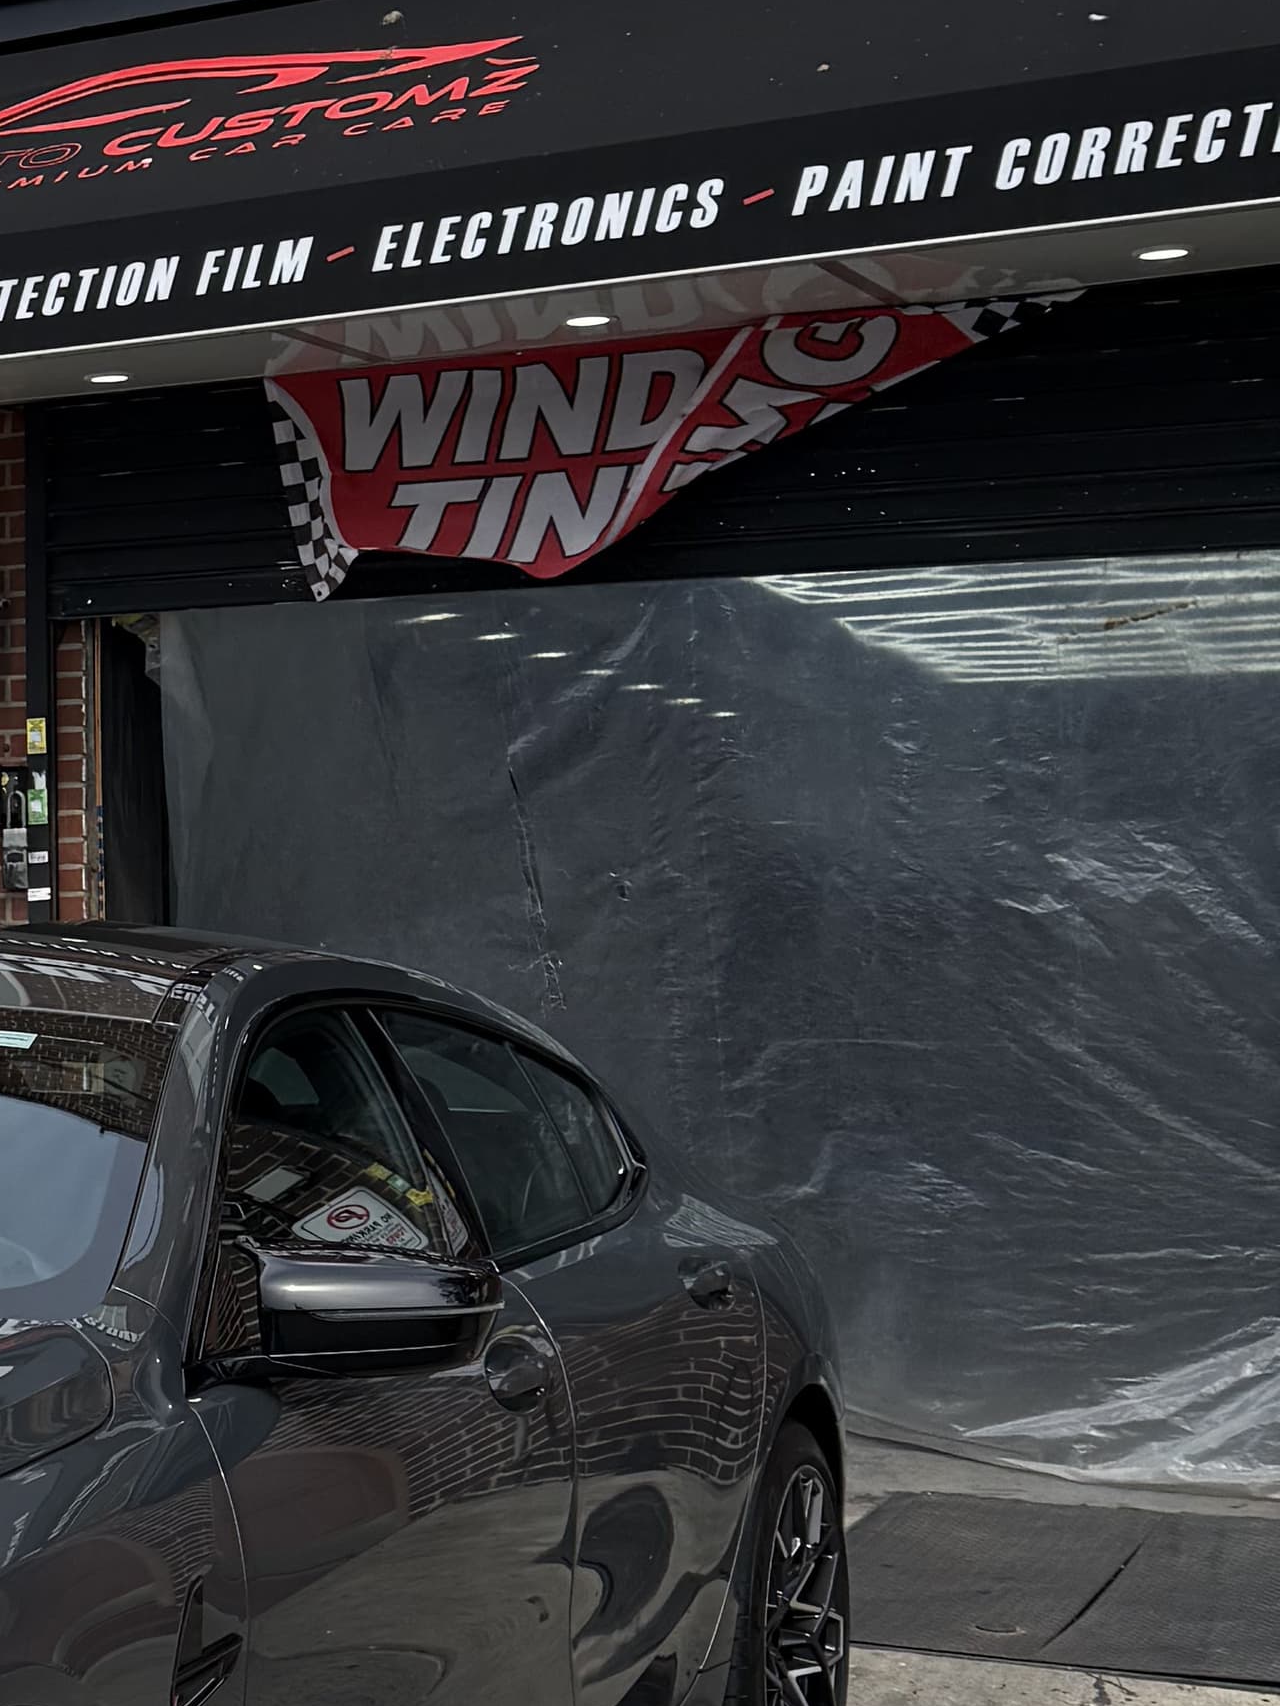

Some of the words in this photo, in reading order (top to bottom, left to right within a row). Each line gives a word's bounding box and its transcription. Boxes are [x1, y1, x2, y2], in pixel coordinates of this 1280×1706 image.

[102, 57, 540, 158] CUSTOMZ
[190, 132, 306, 162] CAR
[344, 99, 512, 136] CARE
[196, 236, 315, 296] FILM
[371, 176, 725, 274] ELECTRONICS
[791, 144, 973, 217] PAINT
[338, 347, 707, 474] WIND
[390, 463, 636, 563] TIN
